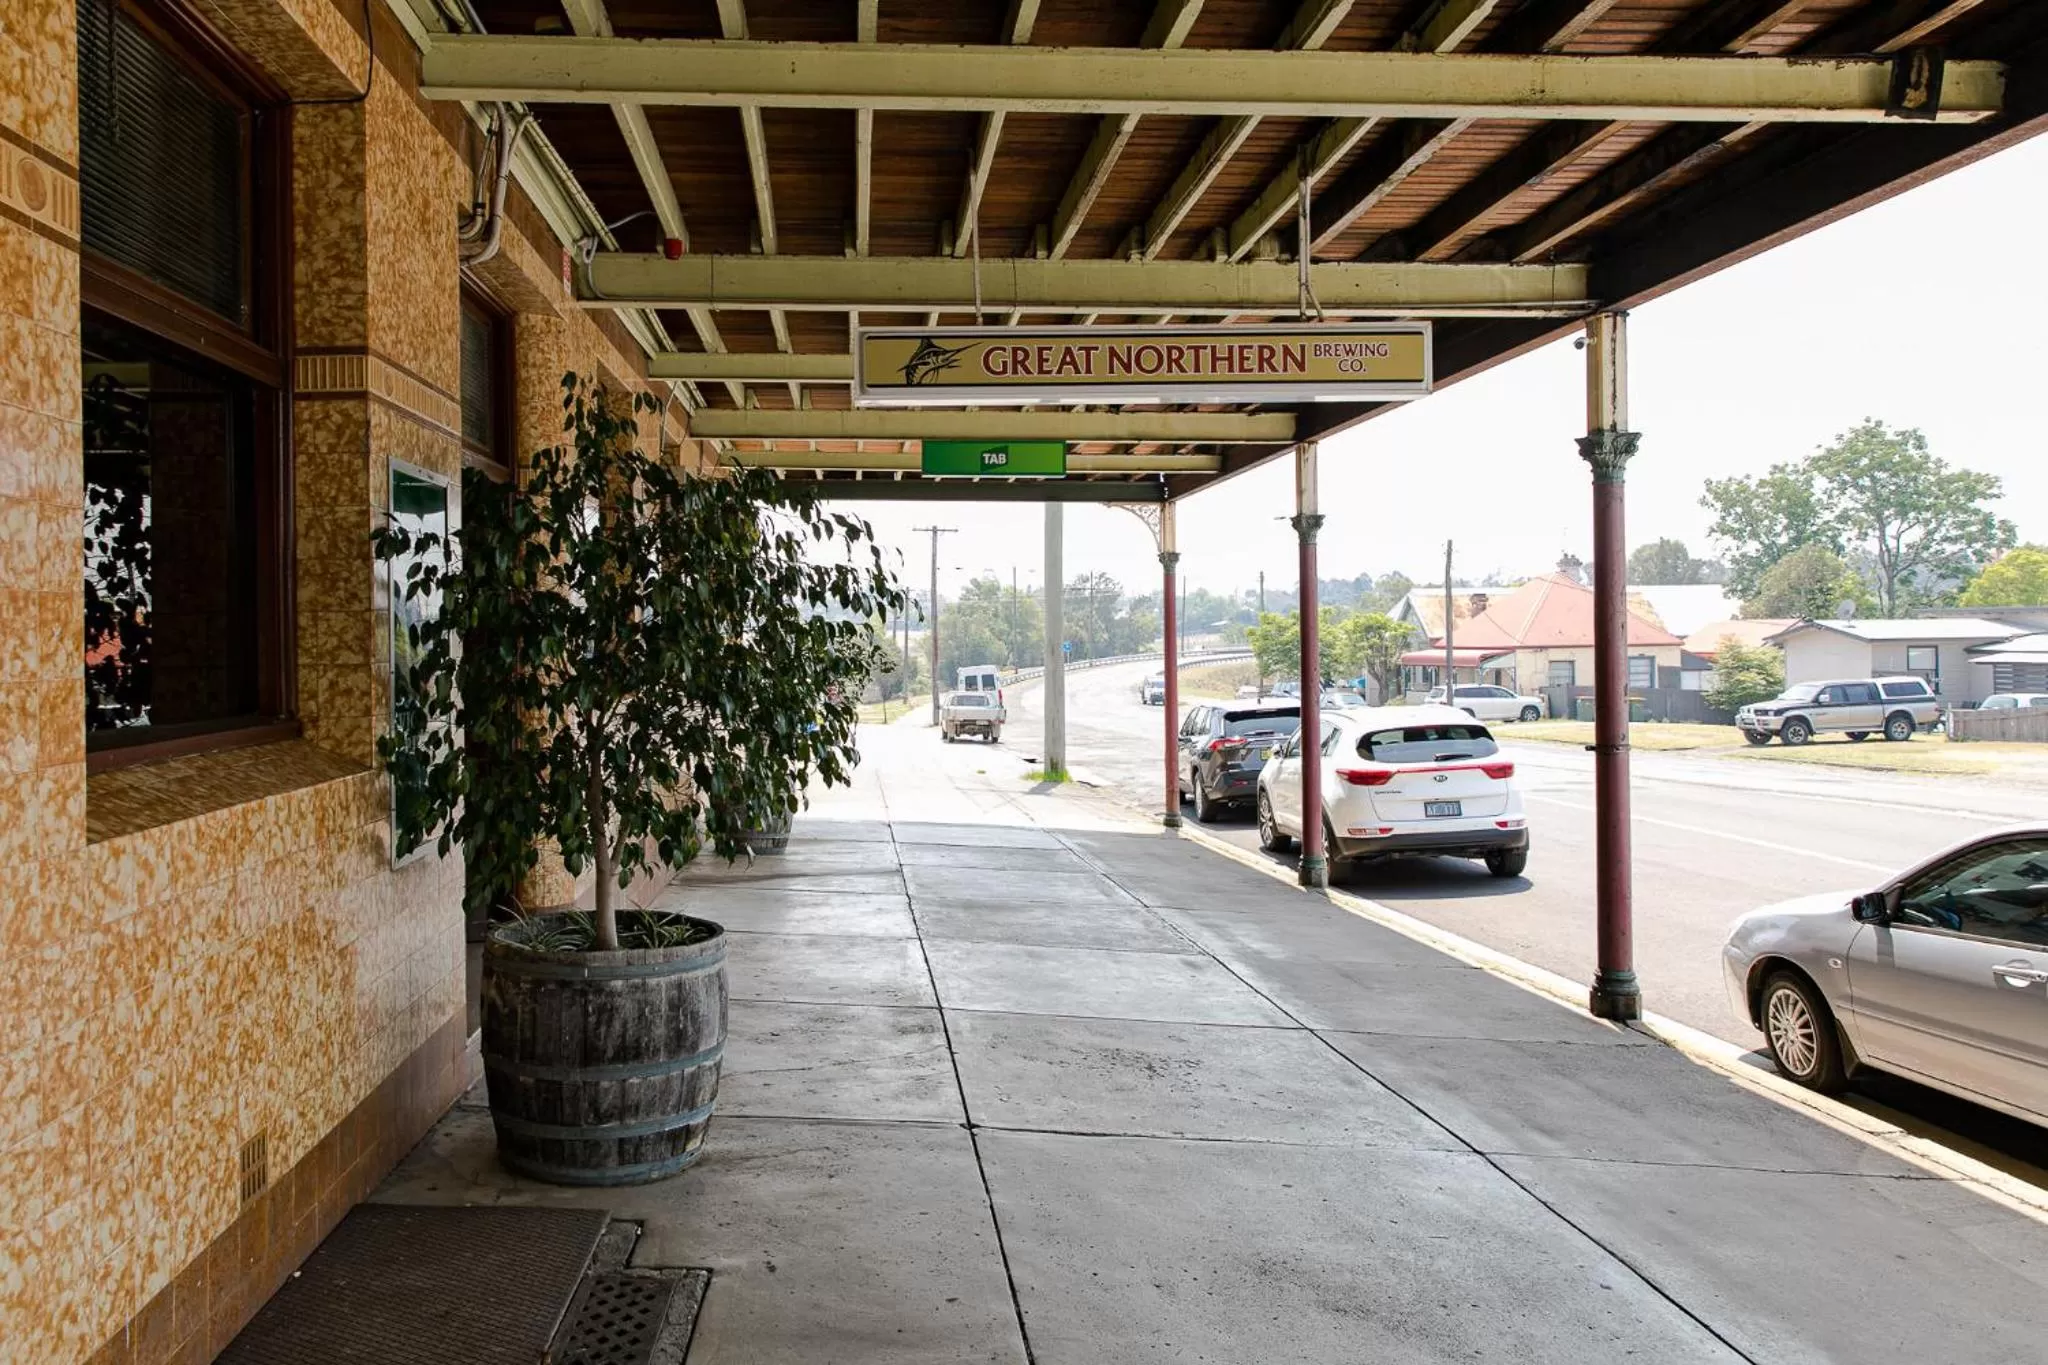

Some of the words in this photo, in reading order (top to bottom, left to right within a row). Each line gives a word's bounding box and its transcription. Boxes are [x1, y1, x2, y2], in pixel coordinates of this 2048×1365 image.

[1313, 343, 1389, 358] BREWING
[982, 344, 1100, 377] GREAT
[1107, 343, 1308, 376] NORTHERN
[1337, 358, 1367, 372] CO.
[982, 452, 1007, 465] TAB
